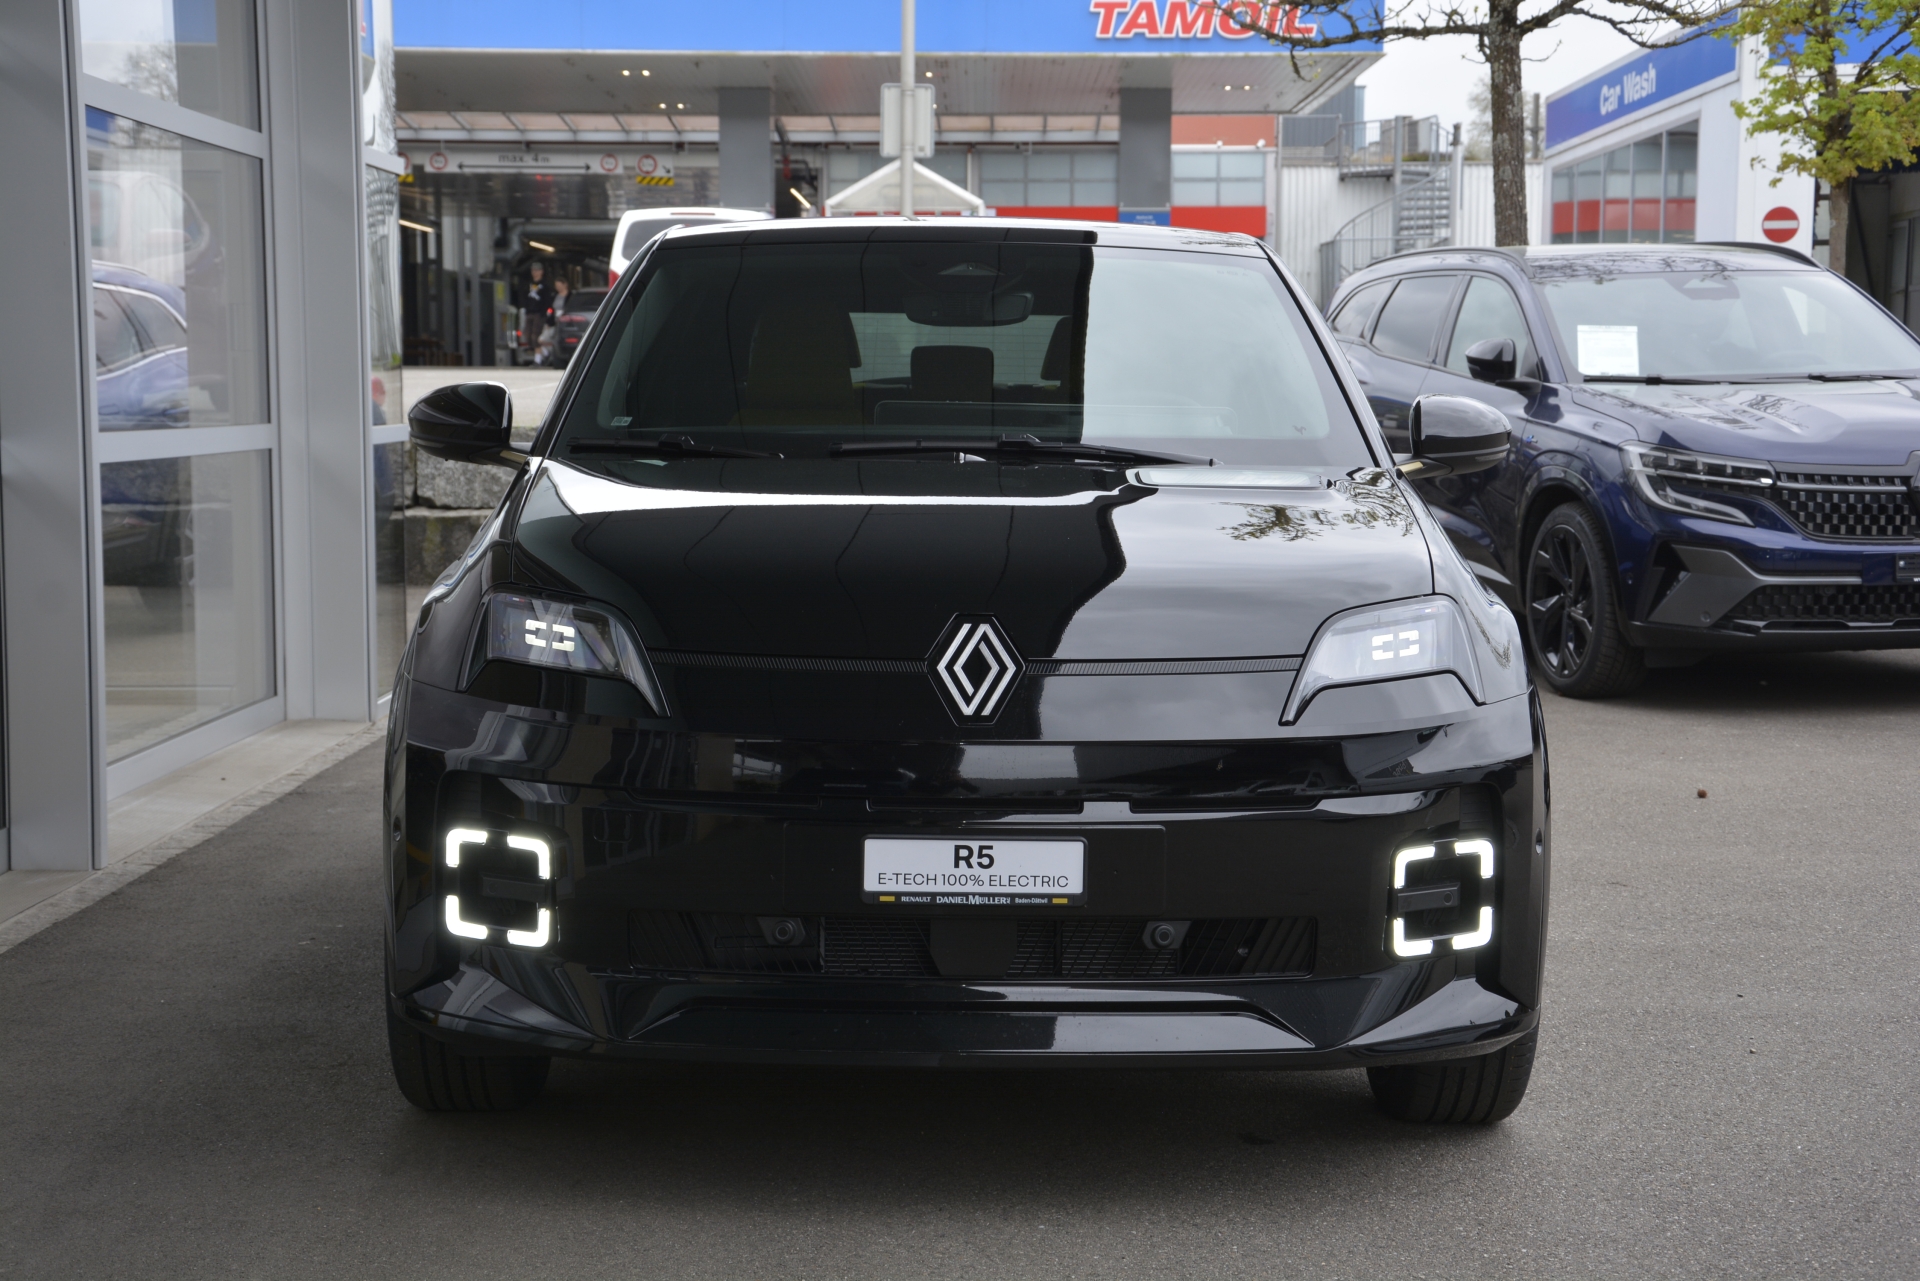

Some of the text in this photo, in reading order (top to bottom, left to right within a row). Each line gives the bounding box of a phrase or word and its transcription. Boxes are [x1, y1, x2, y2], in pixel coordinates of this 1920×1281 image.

[1090, 0, 1318, 39] TAMOIL
[1600, 62, 1657, 116] Car Wash
[498, 153, 529, 163] max.
[953, 844, 995, 870] R5
[878, 872, 1069, 888] E-TECH 100% ELECTRIC
[901, 896, 932, 904] RENAULT
